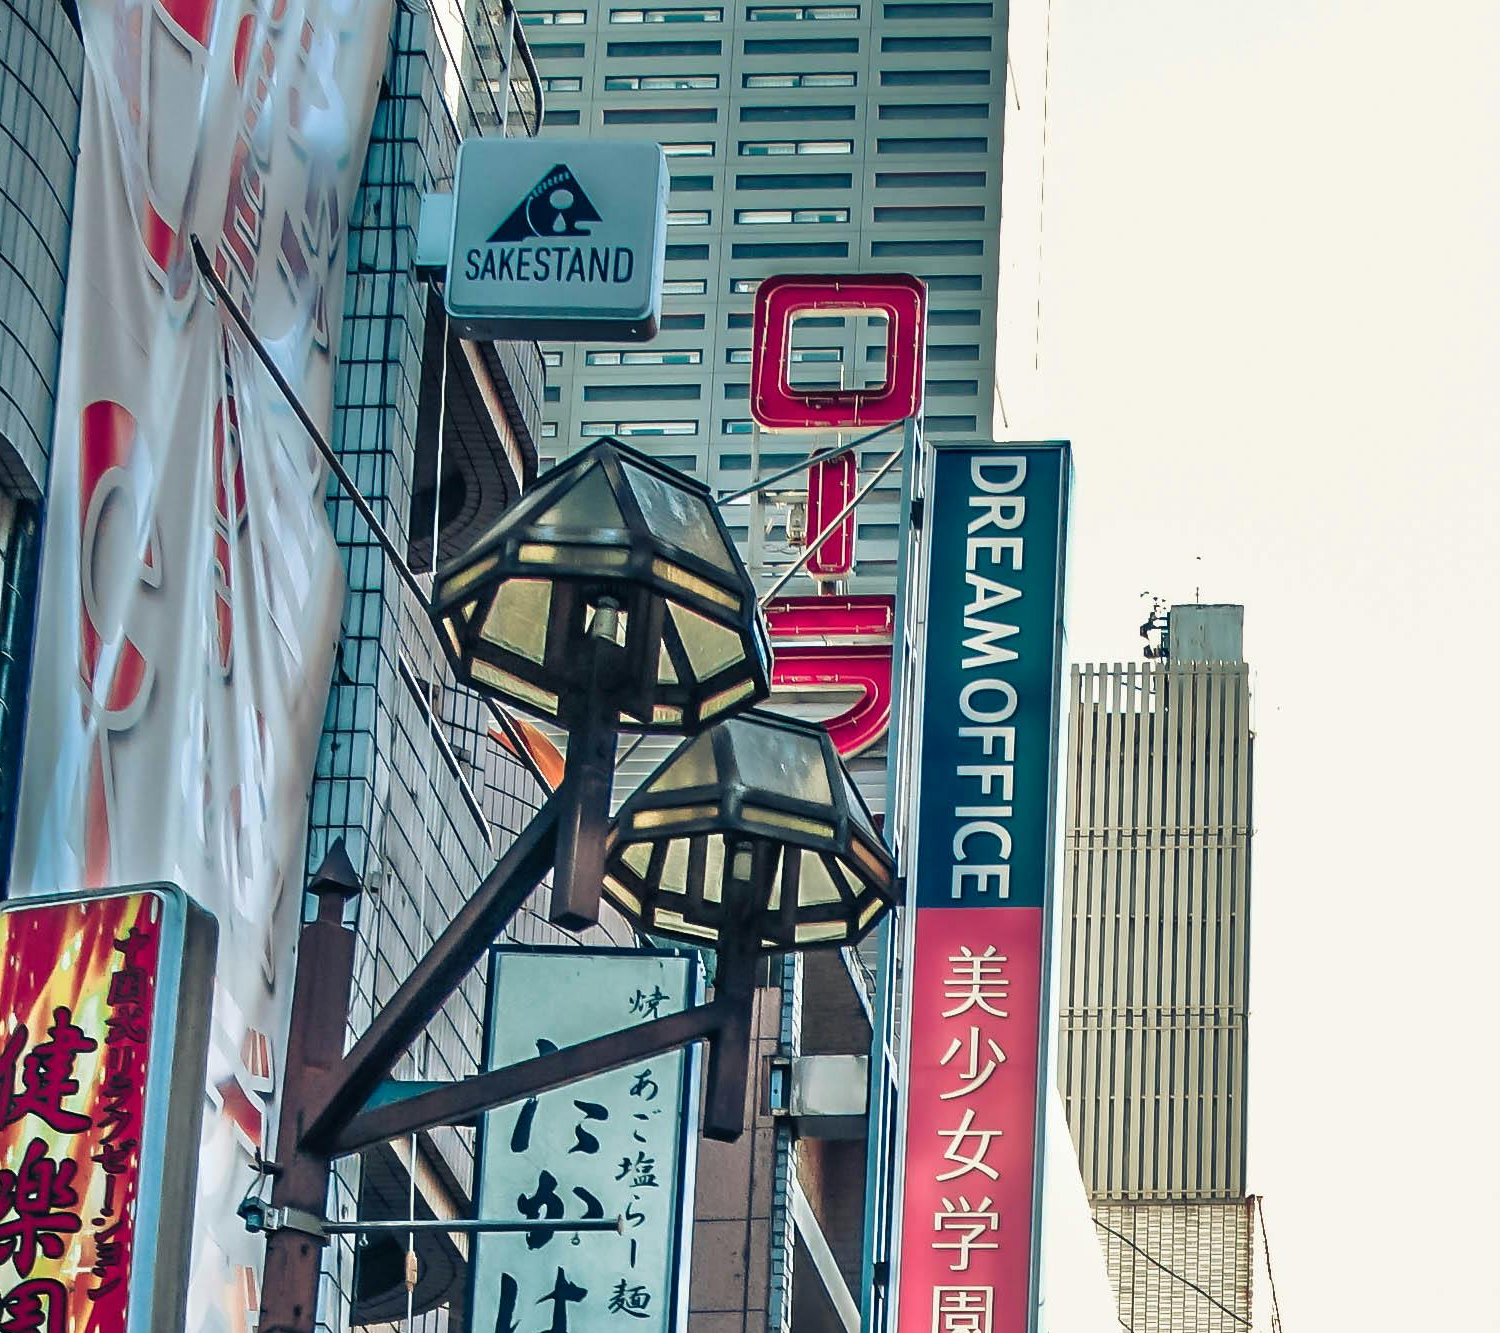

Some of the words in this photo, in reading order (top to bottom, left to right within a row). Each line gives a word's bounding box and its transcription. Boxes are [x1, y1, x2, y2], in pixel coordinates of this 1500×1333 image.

[464, 246, 635, 285] SAKESTAND
[960, 454, 1027, 672] DREAM
[950, 677, 1019, 901] OFFICE
[606, 982, 671, 1319] 焼あご塩らー麺
